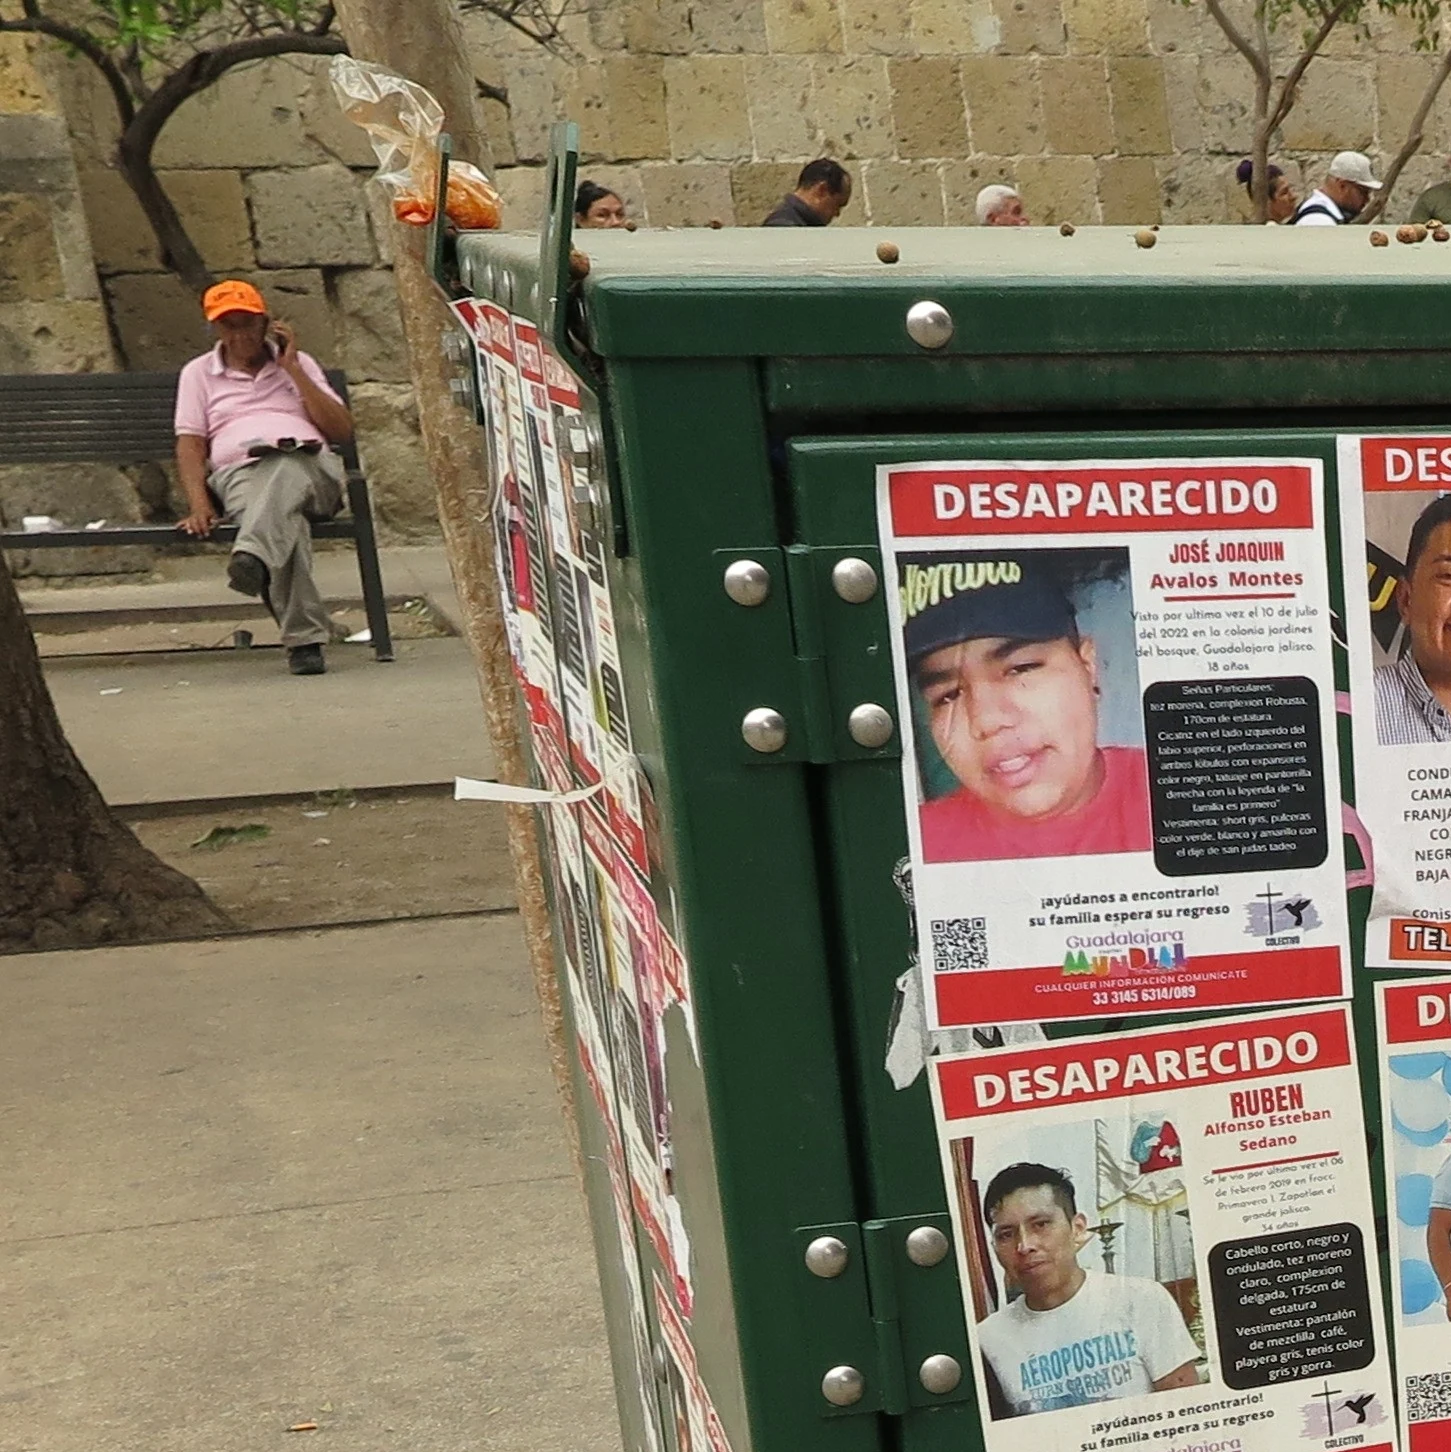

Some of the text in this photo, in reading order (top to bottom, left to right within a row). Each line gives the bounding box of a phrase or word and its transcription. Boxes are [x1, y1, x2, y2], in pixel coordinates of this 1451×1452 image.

[932, 479, 1278, 520] DESAPARECIDO
[1169, 538, 1284, 565] JOSÉ JOAQUIN
[1150, 569, 1303, 590] Avalos Montes
[1416, 870, 1450, 884] BAJA
[1119, 892, 1128, 902] a
[1132, 885, 1219, 901] encontrarlo!
[1029, 903, 1230, 927] su familia espera su regreso
[1065, 929, 1184, 949] Guadalajara
[1092, 991, 1108, 1005] 33
[1112, 989, 1139, 1004] 3145
[972, 1030, 1319, 1110] DESAPARECIDO
[1229, 1083, 1303, 1120] RUBEN
